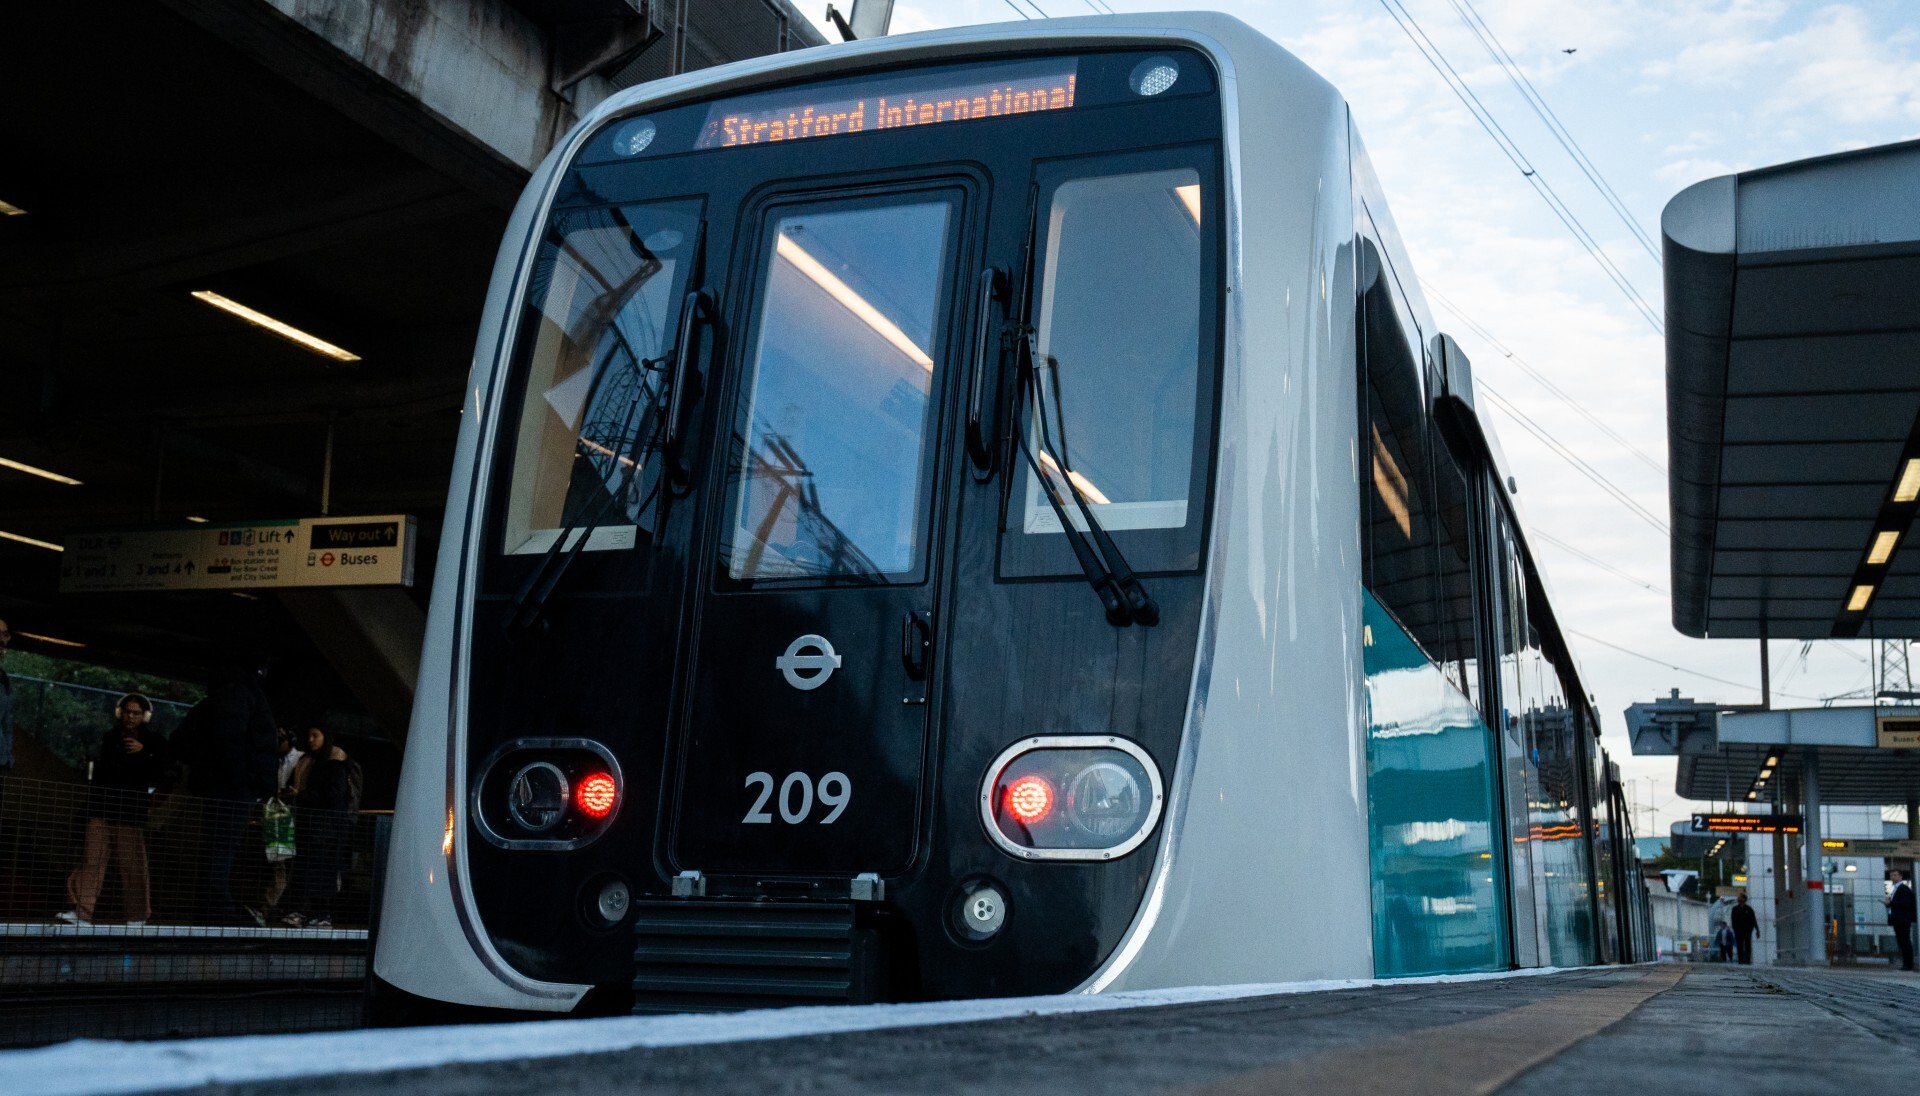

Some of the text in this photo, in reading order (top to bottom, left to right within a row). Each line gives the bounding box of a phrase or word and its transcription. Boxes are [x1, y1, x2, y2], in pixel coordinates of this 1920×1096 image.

[722, 74, 1075, 147] Stratford International
[259, 530, 281, 543] Lift
[328, 528, 381, 544] Way out
[79, 538, 103, 550] DLR
[341, 553, 378, 565] Buses
[85, 563, 106, 577] and
[136, 562, 182, 575] 3 and 4
[741, 771, 852, 825] 209
[1694, 815, 1704, 829] 2
